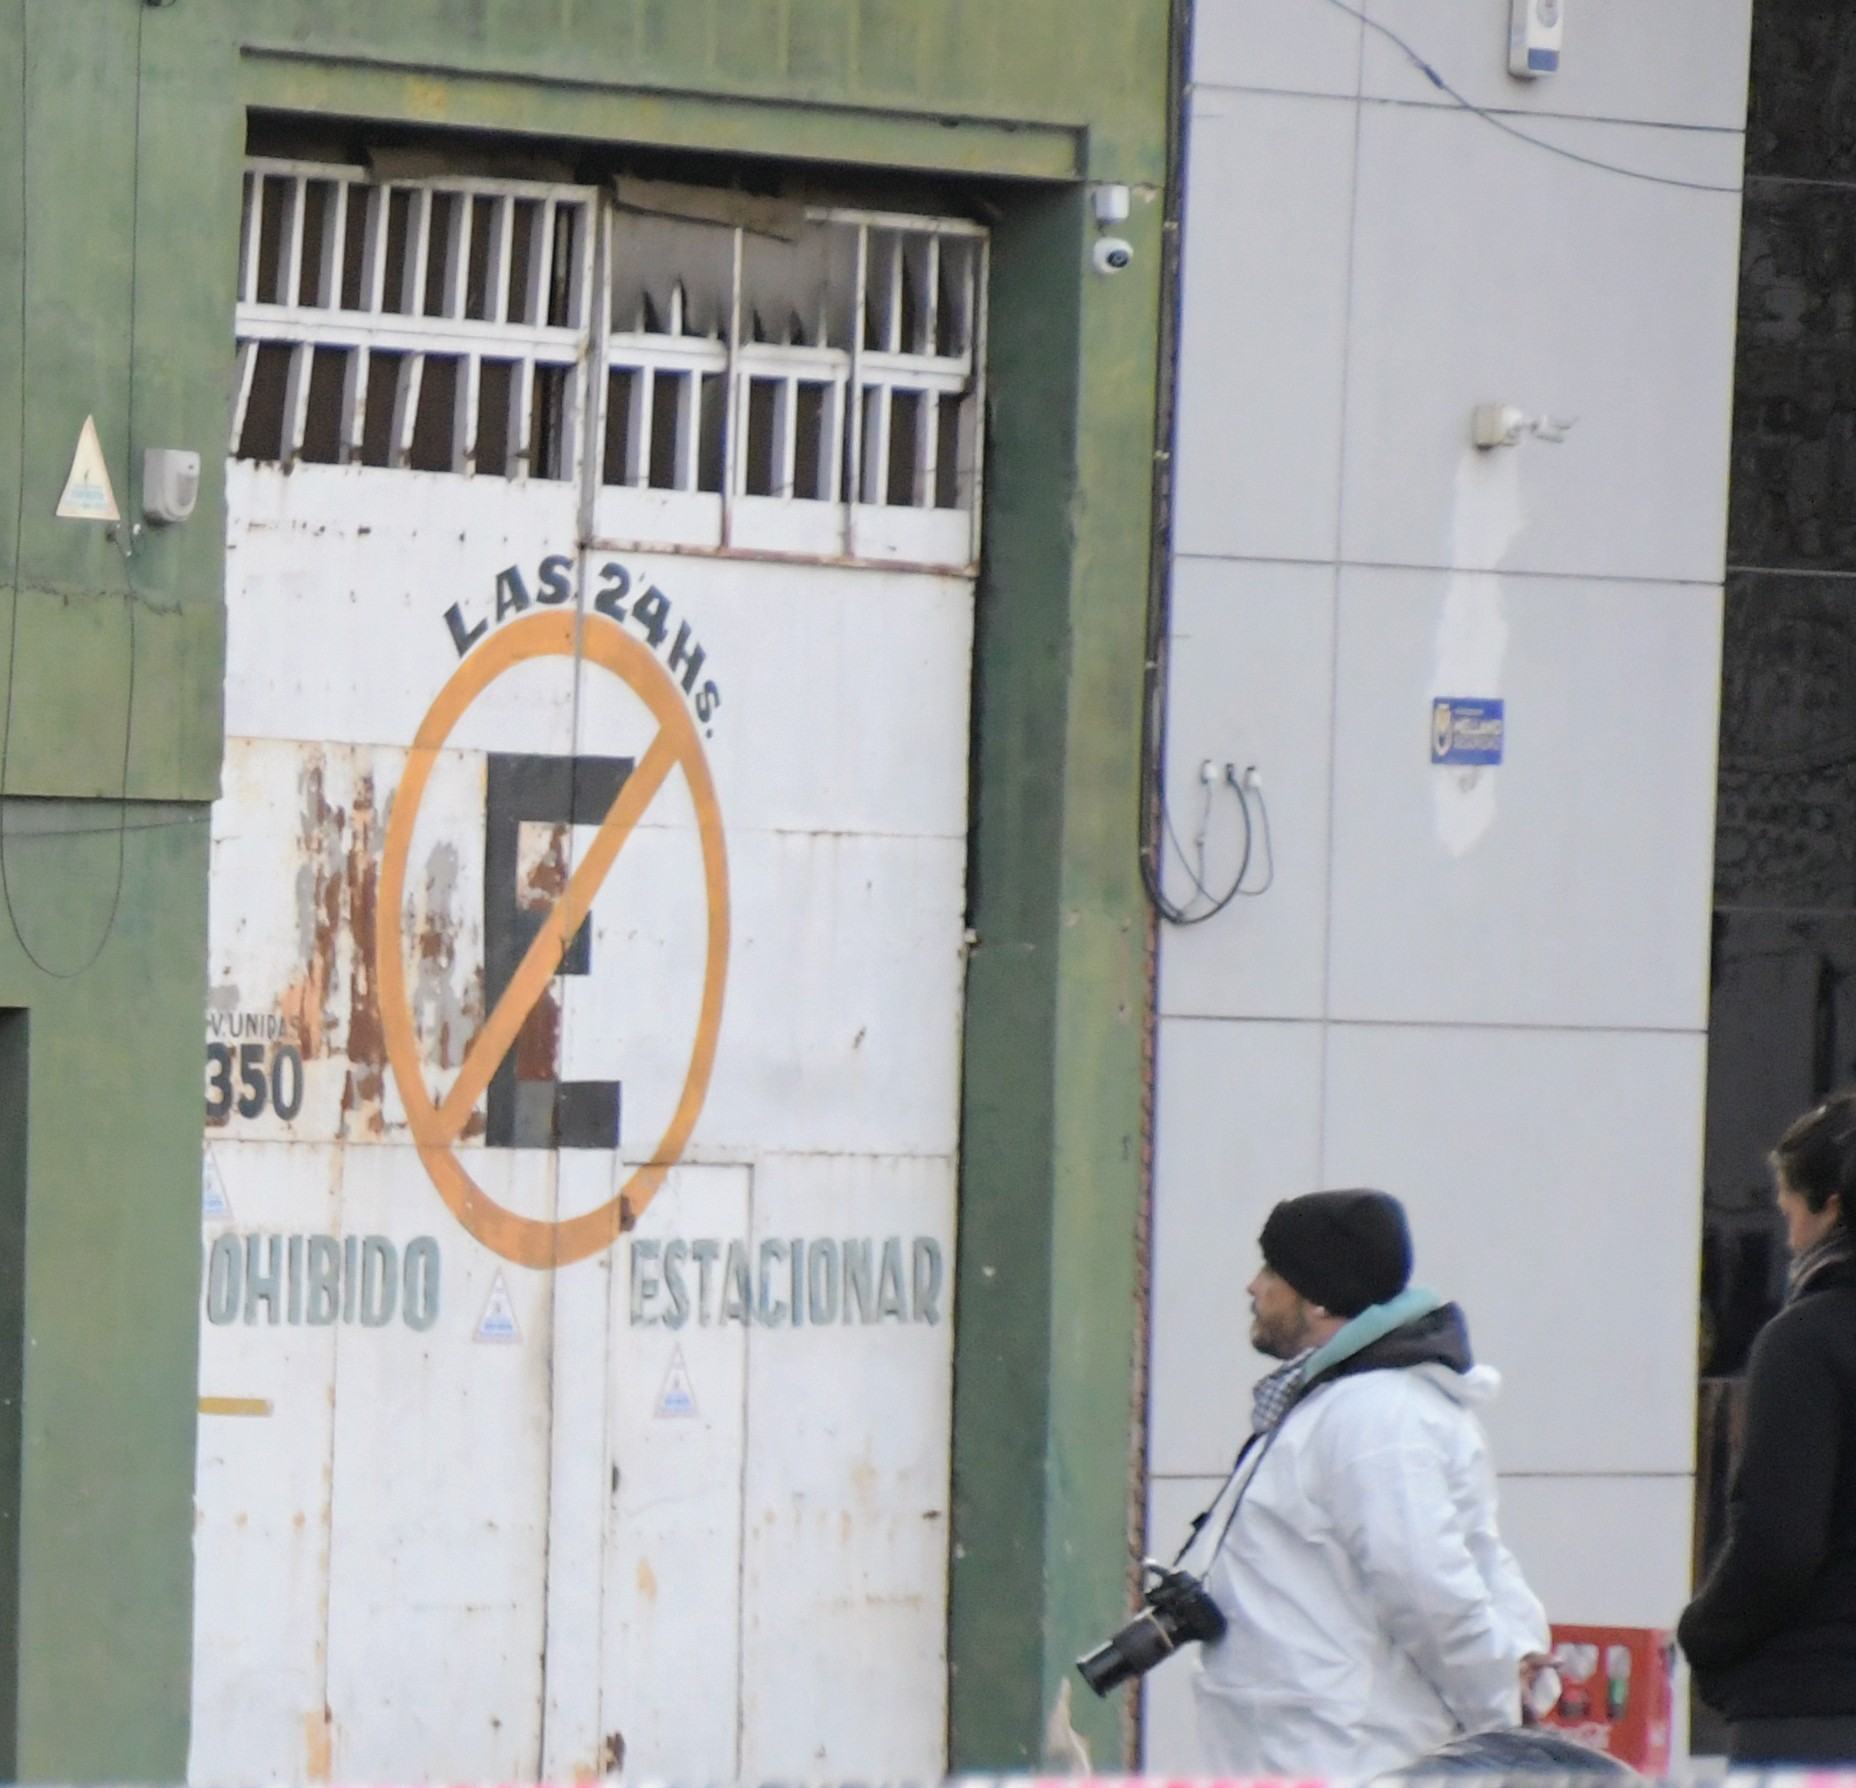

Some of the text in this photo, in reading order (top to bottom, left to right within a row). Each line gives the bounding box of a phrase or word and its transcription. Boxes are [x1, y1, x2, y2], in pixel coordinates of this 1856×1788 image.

[442, 553, 575, 659] LAS
[484, 752, 635, 1149] E
[206, 1041, 304, 1121] 350
[627, 1234, 944, 1332] ESTACIONAR
